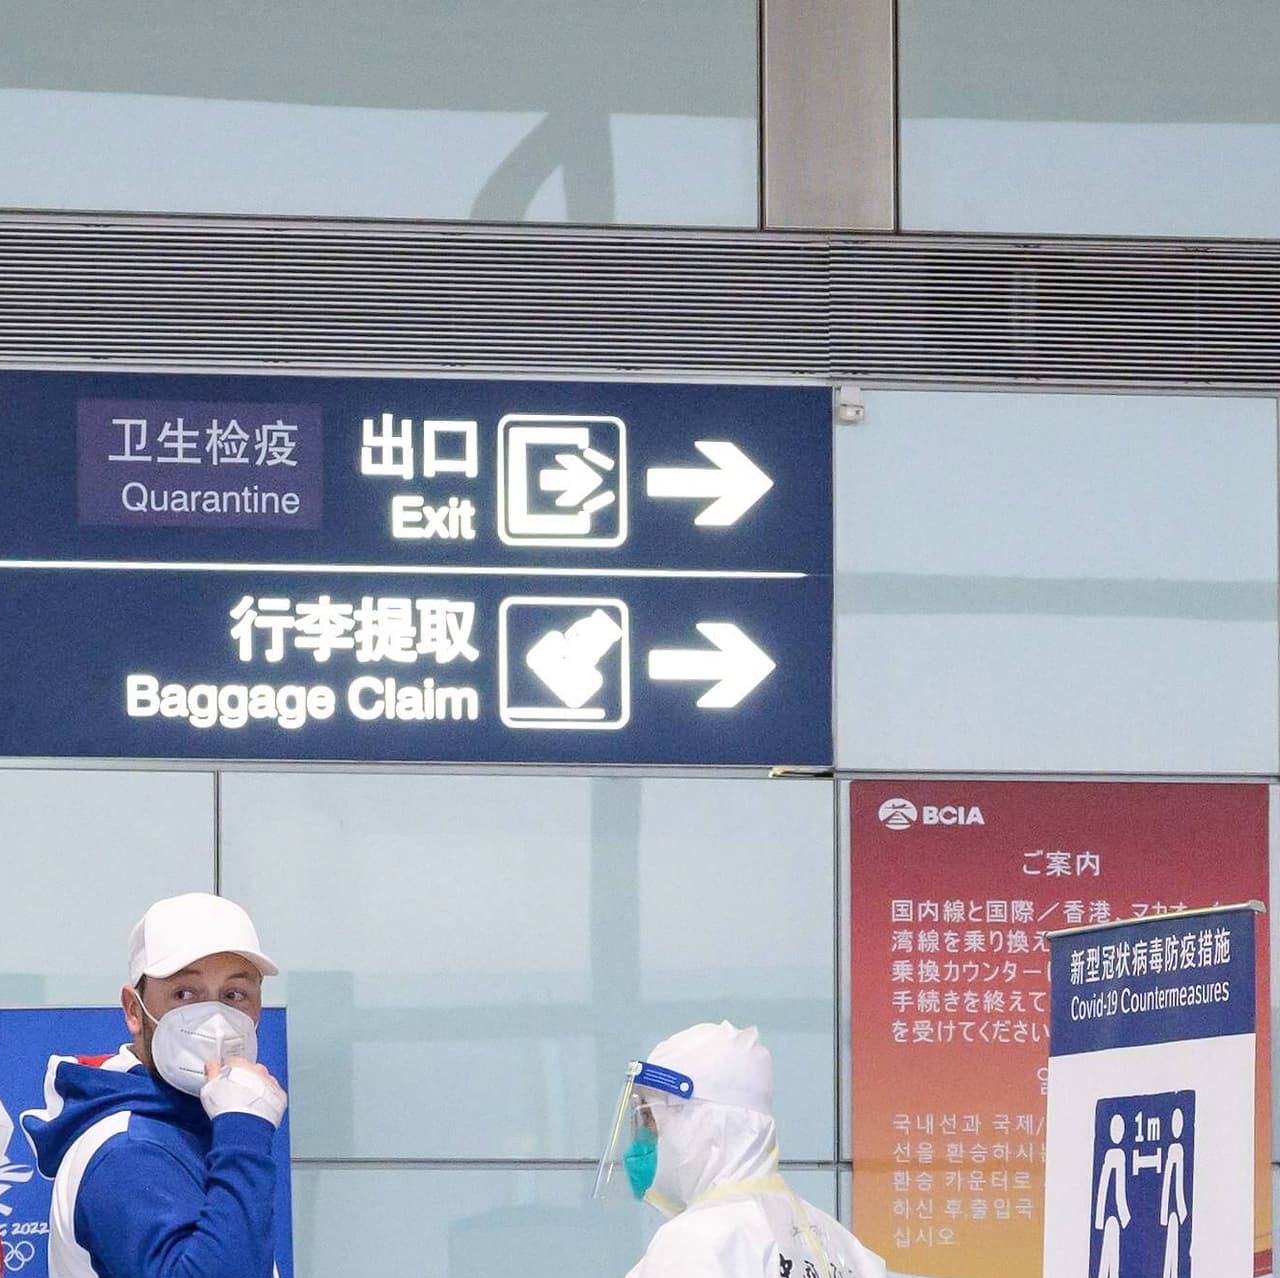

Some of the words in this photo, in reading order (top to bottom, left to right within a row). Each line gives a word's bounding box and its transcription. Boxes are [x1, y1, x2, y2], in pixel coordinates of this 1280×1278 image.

[108, 418, 299, 469] 卫生检疫
[360, 414, 478, 480] 出口
[121, 483, 300, 516] Quarantine
[392, 497, 476, 540] Exit
[230, 597, 479, 663] 行李提取
[127, 675, 335, 728] Baggage
[348, 676, 479, 722] Claim
[923, 806, 985, 825] BCIA
[1022, 851, 1101, 877] ご案内
[1070, 928, 1231, 985] 新型冠状病毒防疫措施
[1071, 990, 1118, 1021] Covid-19
[1121, 981, 1229, 1014] Countermeasures
[893, 1113, 982, 1135] 국내선과
[1135, 1111, 1160, 1142] 1m
[893, 1142, 934, 1163] 선을
[893, 1170, 934, 1192] 환승
[945, 1170, 1032, 1192] 카운터로
[11, 1222, 50, 1236] 2022
